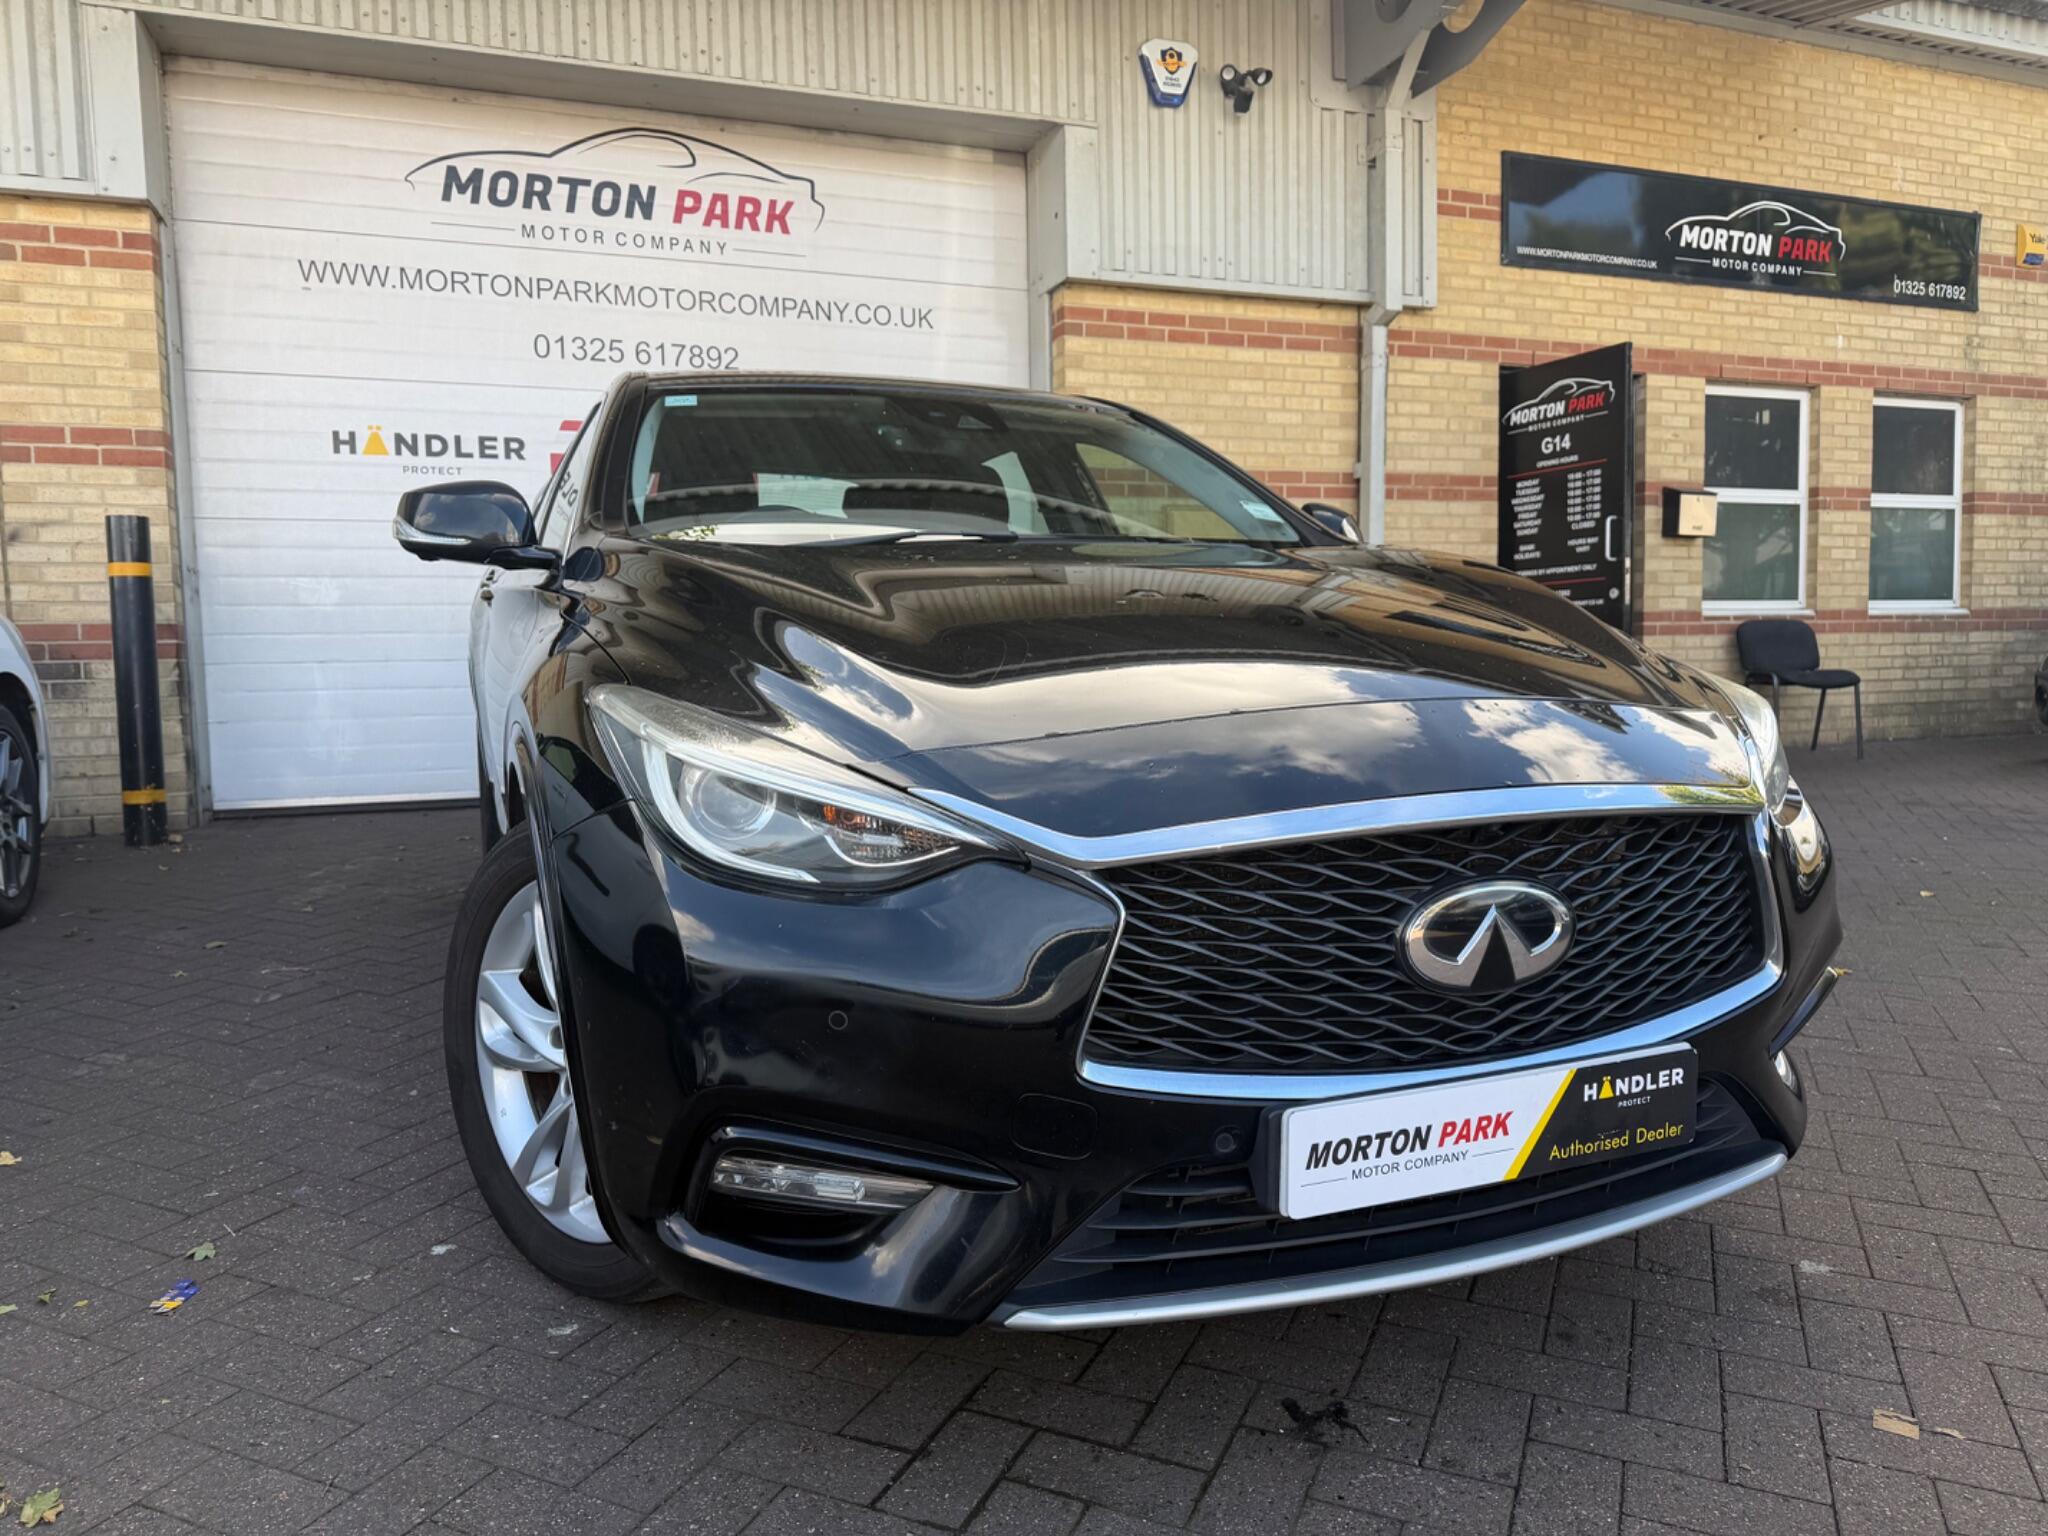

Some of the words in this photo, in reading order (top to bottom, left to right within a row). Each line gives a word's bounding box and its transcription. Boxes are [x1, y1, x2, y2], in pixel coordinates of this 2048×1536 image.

[441, 164, 656, 221] MORTON
[672, 188, 794, 235] PARK
[521, 223, 605, 245] MOTOR
[615, 231, 728, 256] COMPANY
[1679, 224, 1773, 257] MORTON
[1777, 235, 1833, 263] PARK
[1712, 257, 1749, 271] MOTOR
[1751, 261, 1802, 277] COMPANY
[297, 258, 934, 329] WWW.MORTONPARKMOTORCOMPANY.CO.UK
[1893, 278, 1926, 296] 01325
[1928, 282, 1967, 300] 617892
[534, 333, 625, 364] 01325
[634, 340, 740, 370] 617892
[1509, 399, 1566, 427] MORTON
[1567, 391, 1606, 414] PARK
[1528, 420, 1551, 432] MOTOR
[1552, 414, 1585, 428] COMPANY
[1541, 433, 1571, 455] G14
[402, 465, 463, 476] PROTECT
[1617, 1096, 1652, 1108] PROTECT
[1305, 1124, 1433, 1170] MORTON
[1438, 1110, 1514, 1148] PARK
[1549, 1129, 1629, 1161] Authorised
[1635, 1121, 1684, 1144] Dealer
[1351, 1161, 1400, 1180] MOTOR
[1404, 1150, 1469, 1170] COMPANY
